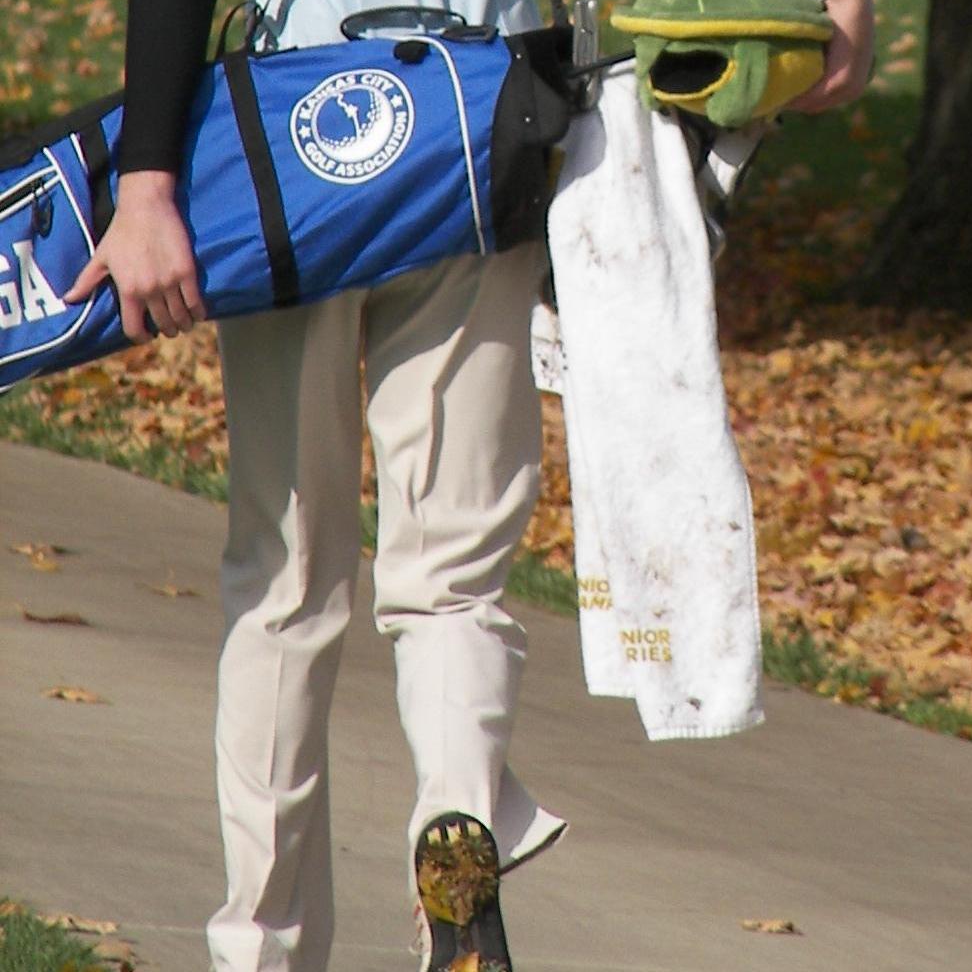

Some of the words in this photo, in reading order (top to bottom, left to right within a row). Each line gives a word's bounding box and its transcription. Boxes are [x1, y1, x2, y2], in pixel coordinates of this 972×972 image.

[299, 74, 356, 120] KANSAS
[361, 73, 395, 92] CITY
[304, 141, 336, 173] GOLF
[334, 111, 408, 177] ASSOCIATION
